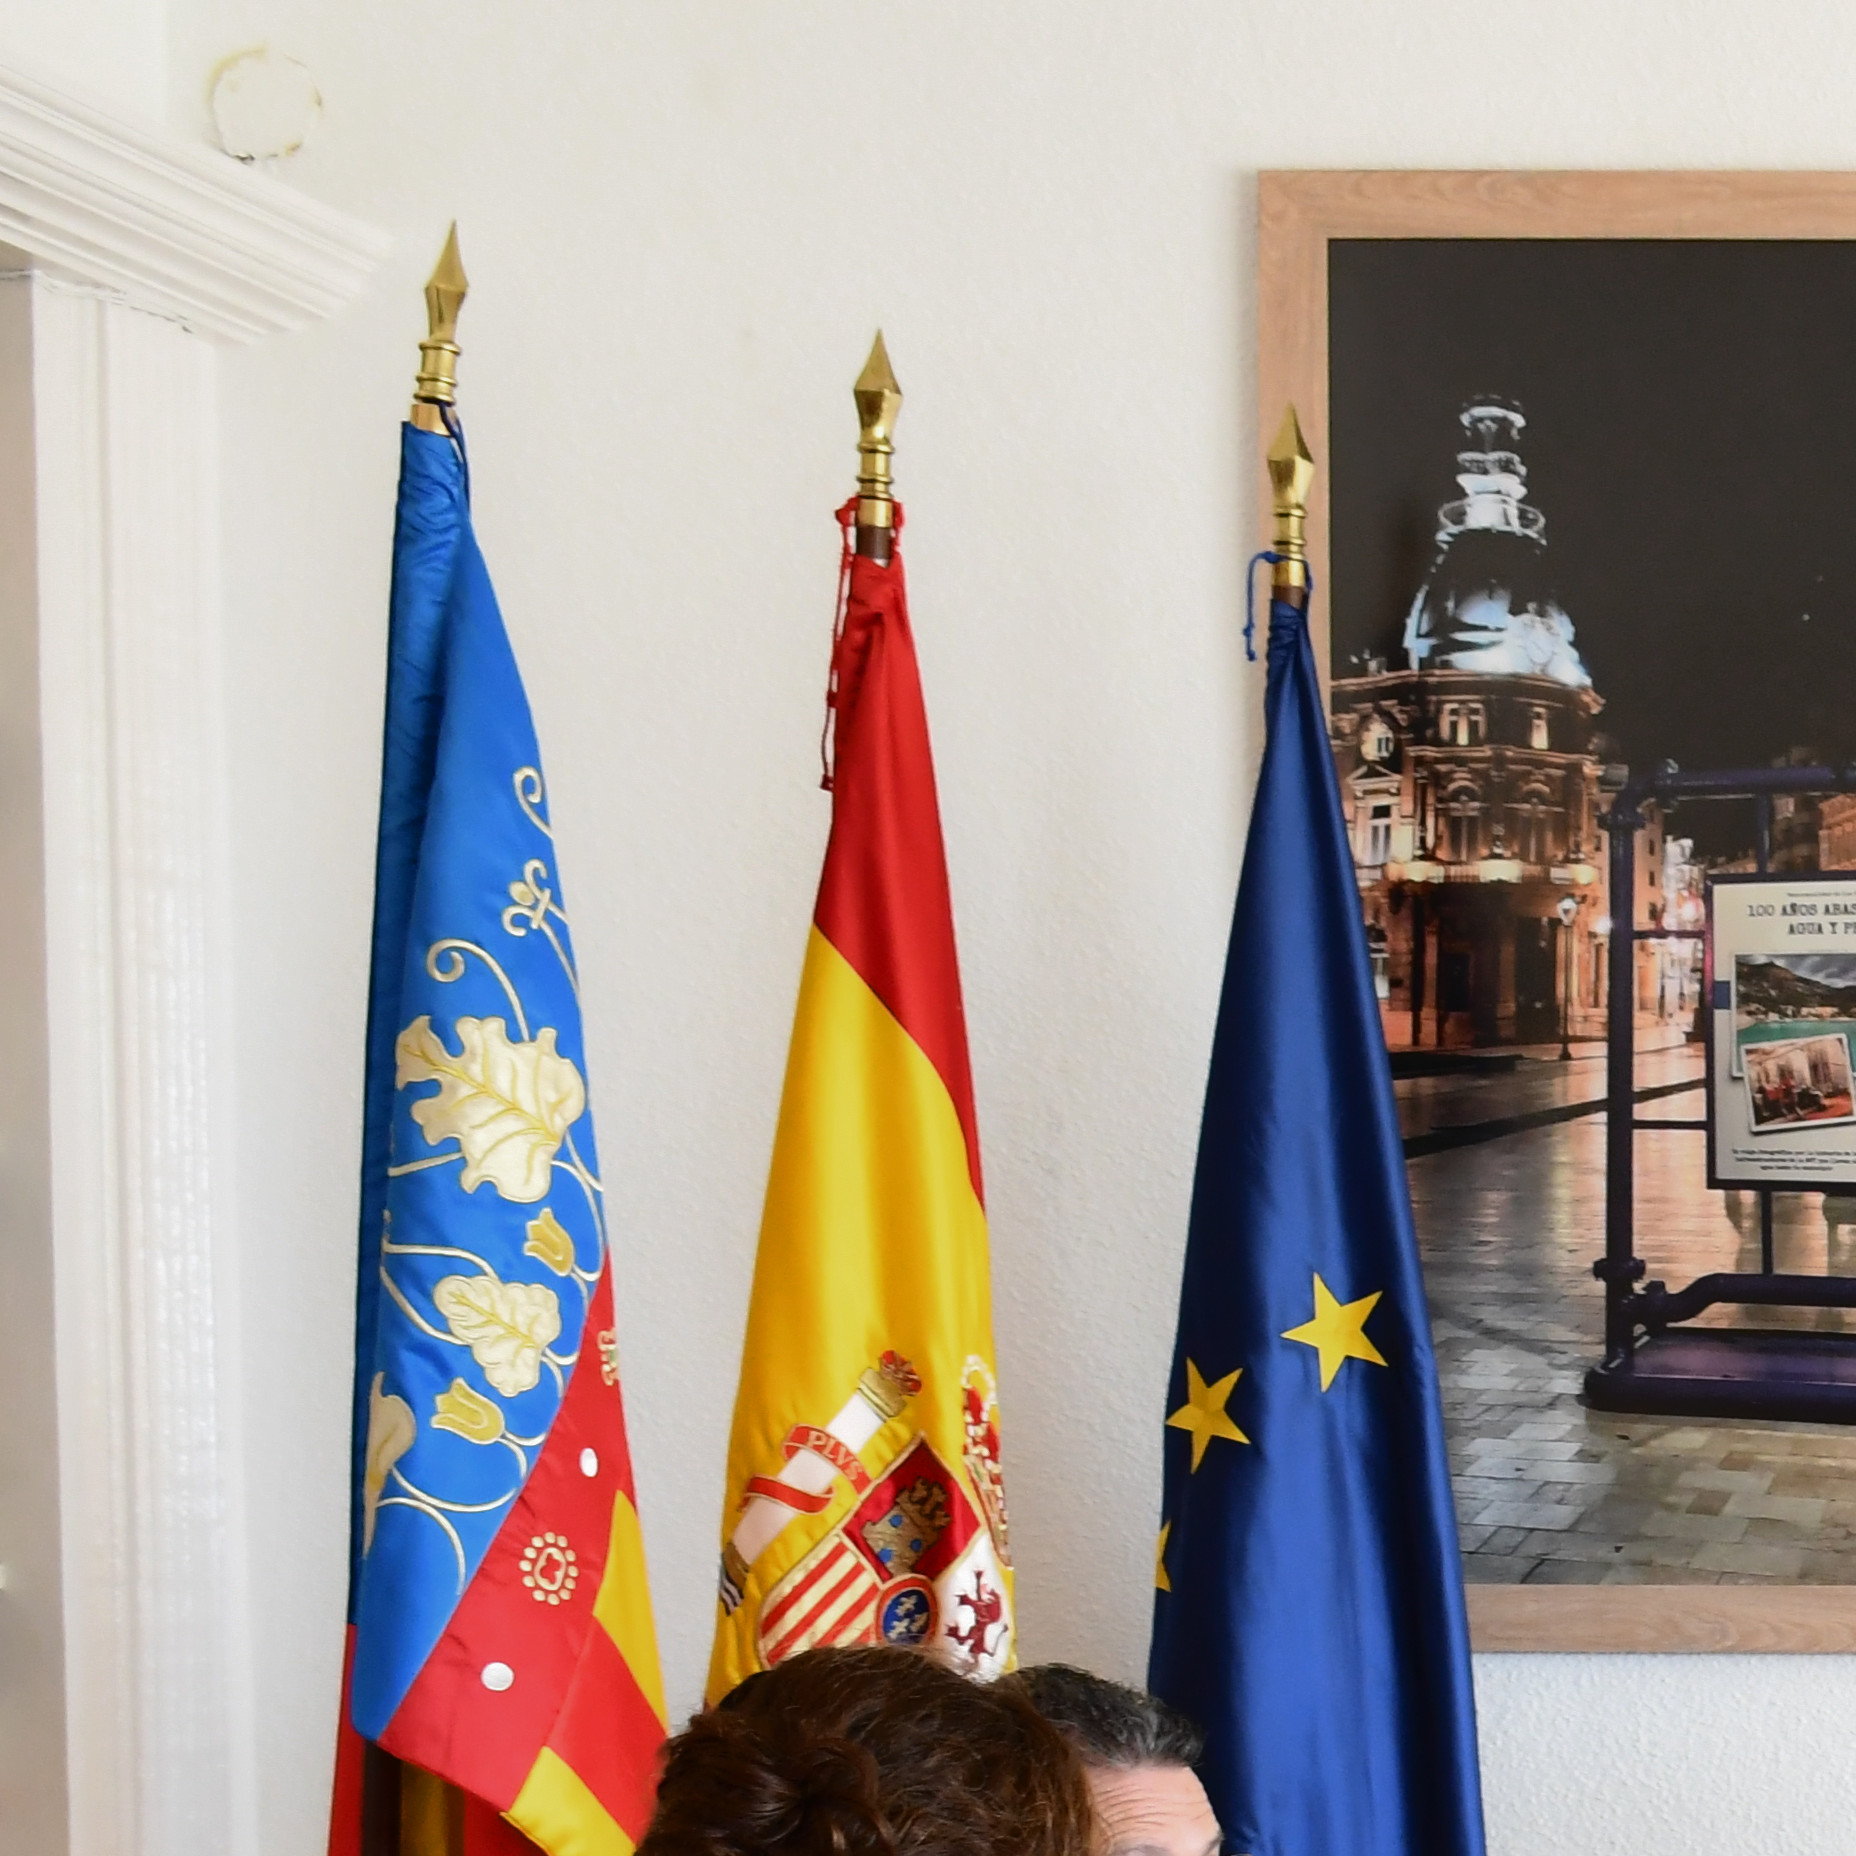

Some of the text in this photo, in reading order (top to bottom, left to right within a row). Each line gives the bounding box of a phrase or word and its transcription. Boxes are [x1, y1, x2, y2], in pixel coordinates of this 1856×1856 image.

[1747, 904, 1775, 917] 100
[1781, 902, 1818, 917] AÑOS
[1788, 922, 1824, 935] AGUA
[1829, 922, 1838, 935] Y
[807, 1430, 863, 1480] PLVS
